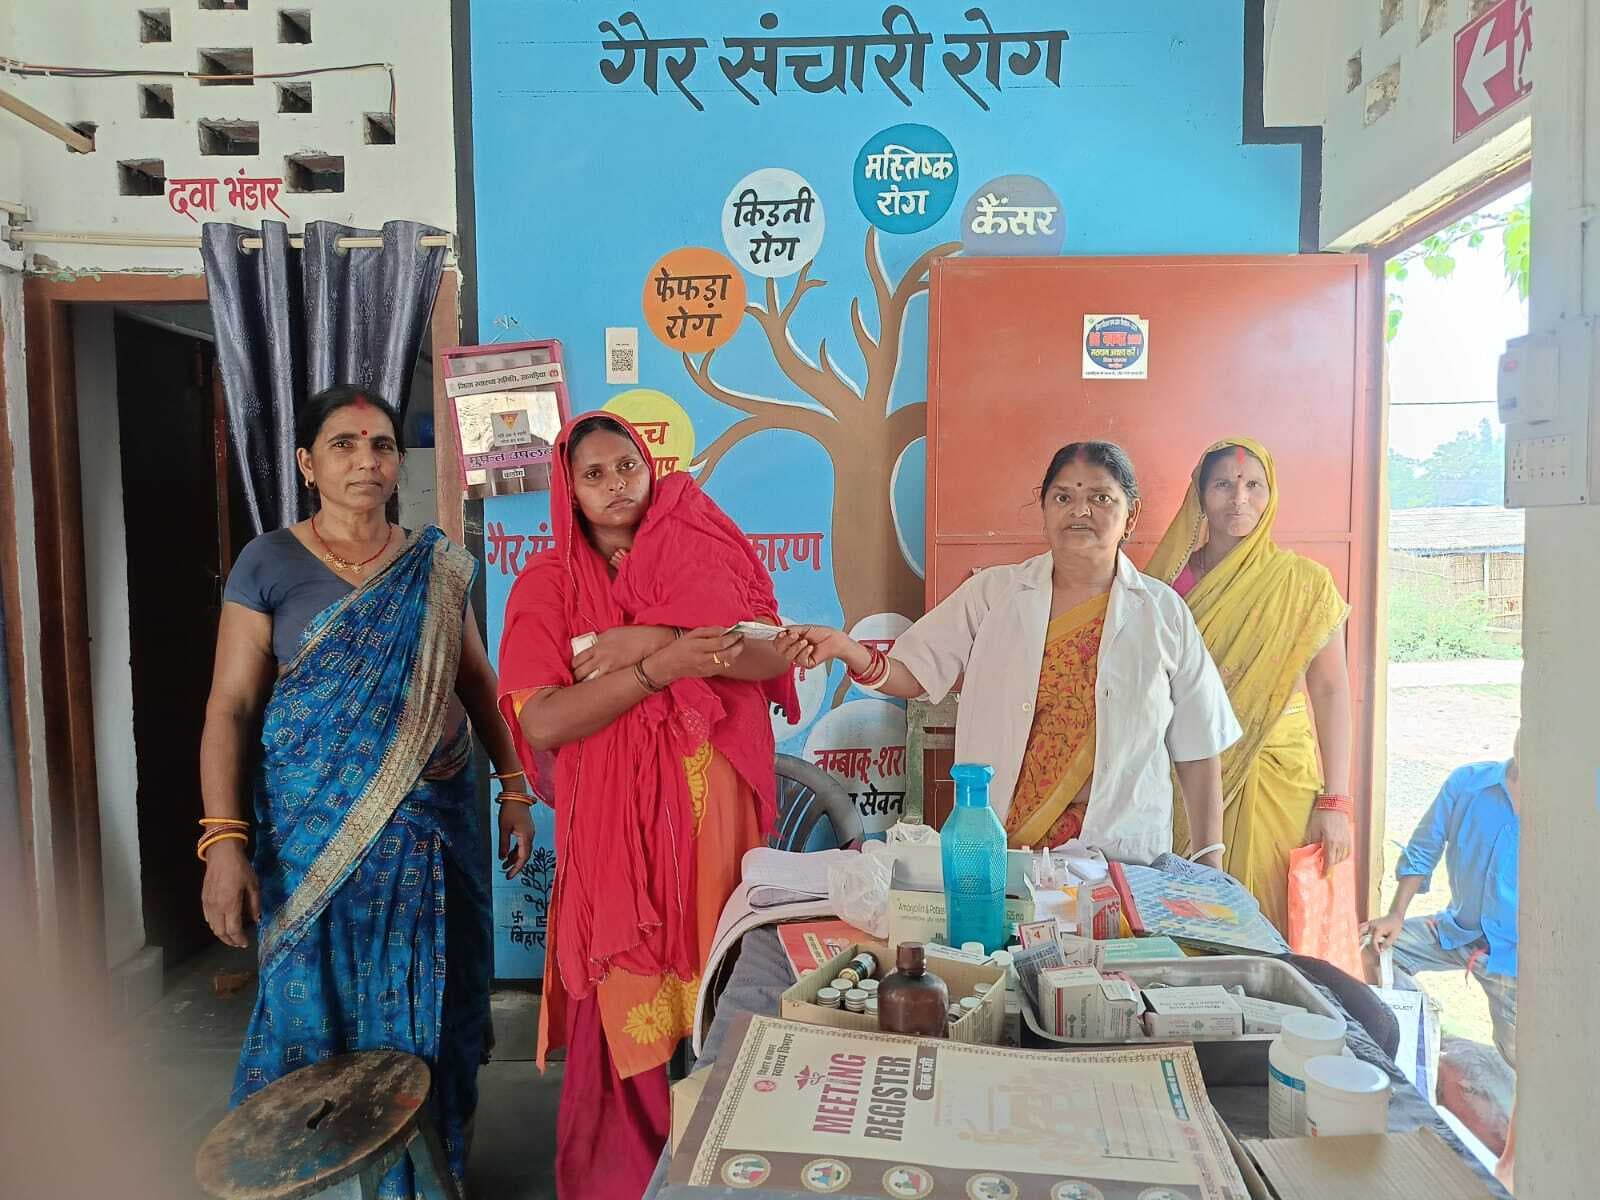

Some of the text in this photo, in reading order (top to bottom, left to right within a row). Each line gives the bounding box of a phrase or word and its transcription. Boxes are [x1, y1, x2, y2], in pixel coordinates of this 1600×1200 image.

[598, 5, 1069, 111] गैर संचारी रोग
[865, 144, 954, 182] मस्तिष्क
[169, 168, 290, 223] दवा भंडार
[733, 187, 815, 227] किडनी
[877, 185, 929, 216] रोग
[971, 193, 1058, 235] कैंसर
[750, 231, 800, 264] रोग
[654, 267, 732, 308] फेफड़ा
[666, 306, 722, 339] रोग
[488, 522, 525, 576] गैर
[860, 783, 906, 816] सेवन
[813, 1052, 867, 1134] MEETING
[864, 1055, 911, 1141] REGISTER
